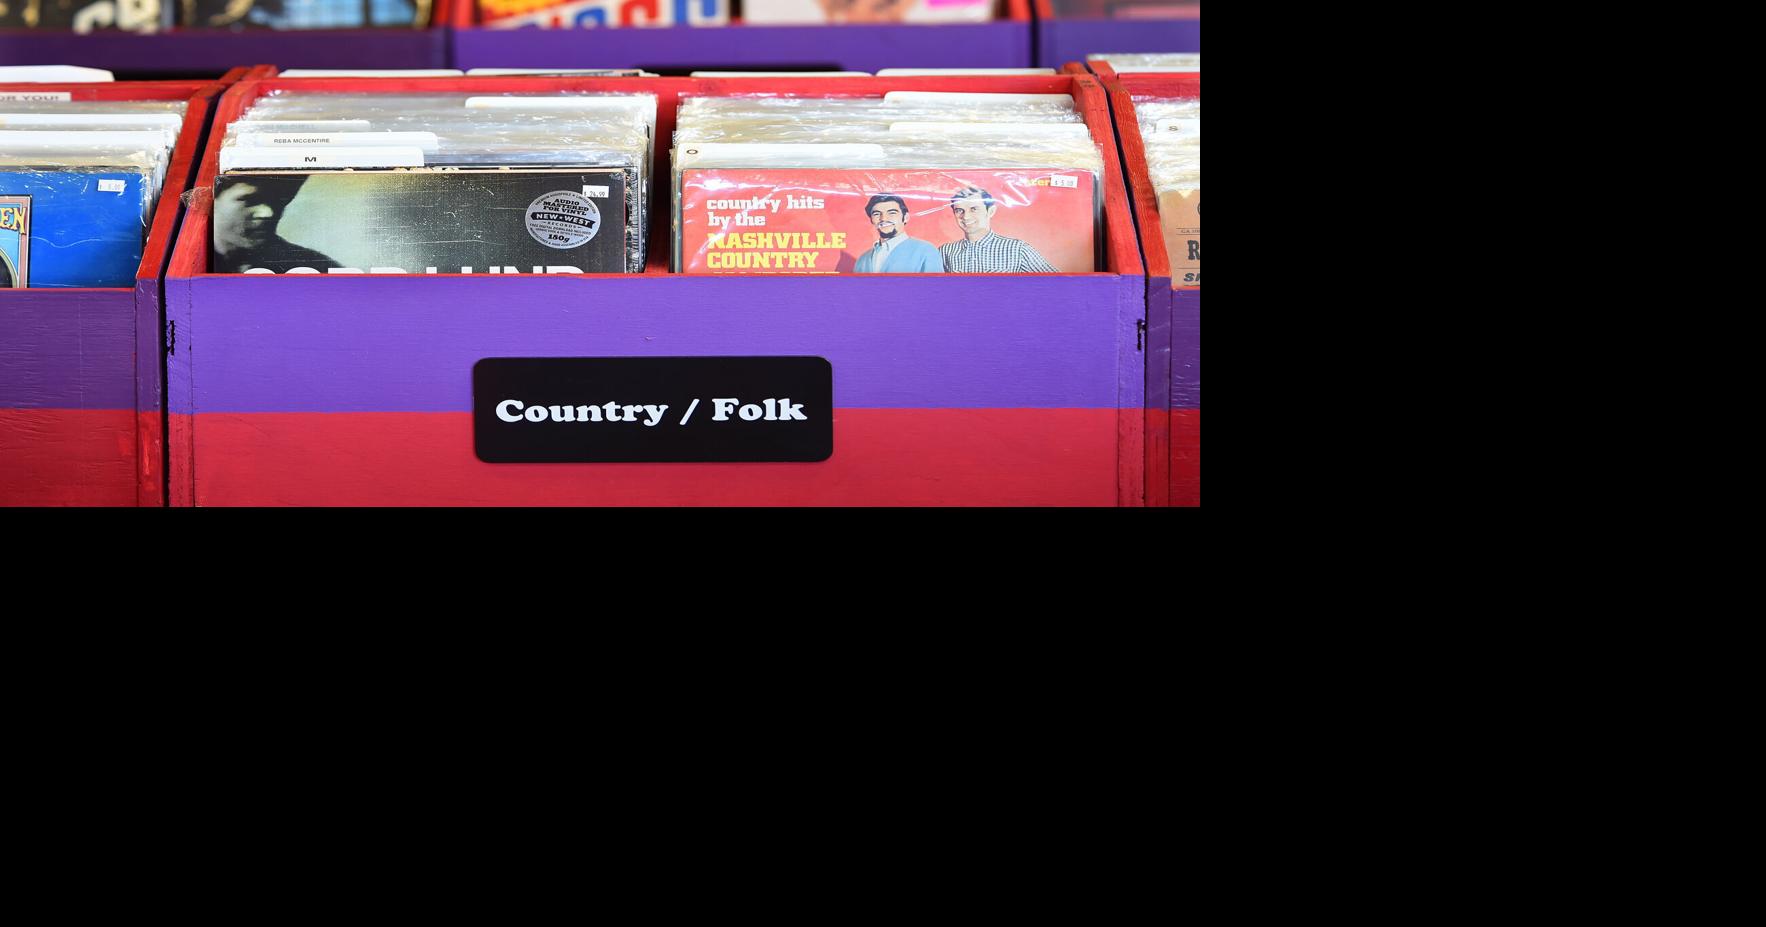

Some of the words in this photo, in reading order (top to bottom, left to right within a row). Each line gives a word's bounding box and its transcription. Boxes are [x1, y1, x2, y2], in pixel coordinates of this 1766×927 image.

[542, 200, 590, 212] MASTERED
[554, 198, 580, 206] AUDIO
[706, 196, 782, 214] country
[786, 194, 825, 210] hits
[561, 208, 588, 216] VINYL
[564, 215, 592, 226] WEST
[707, 211, 731, 230] by
[734, 211, 767, 227] the
[706, 231, 847, 249] NASHVILLE
[706, 251, 820, 269] COUNTRY
[495, 398, 669, 427] Country
[679, 398, 700, 426] /
[711, 397, 808, 422] Folk
